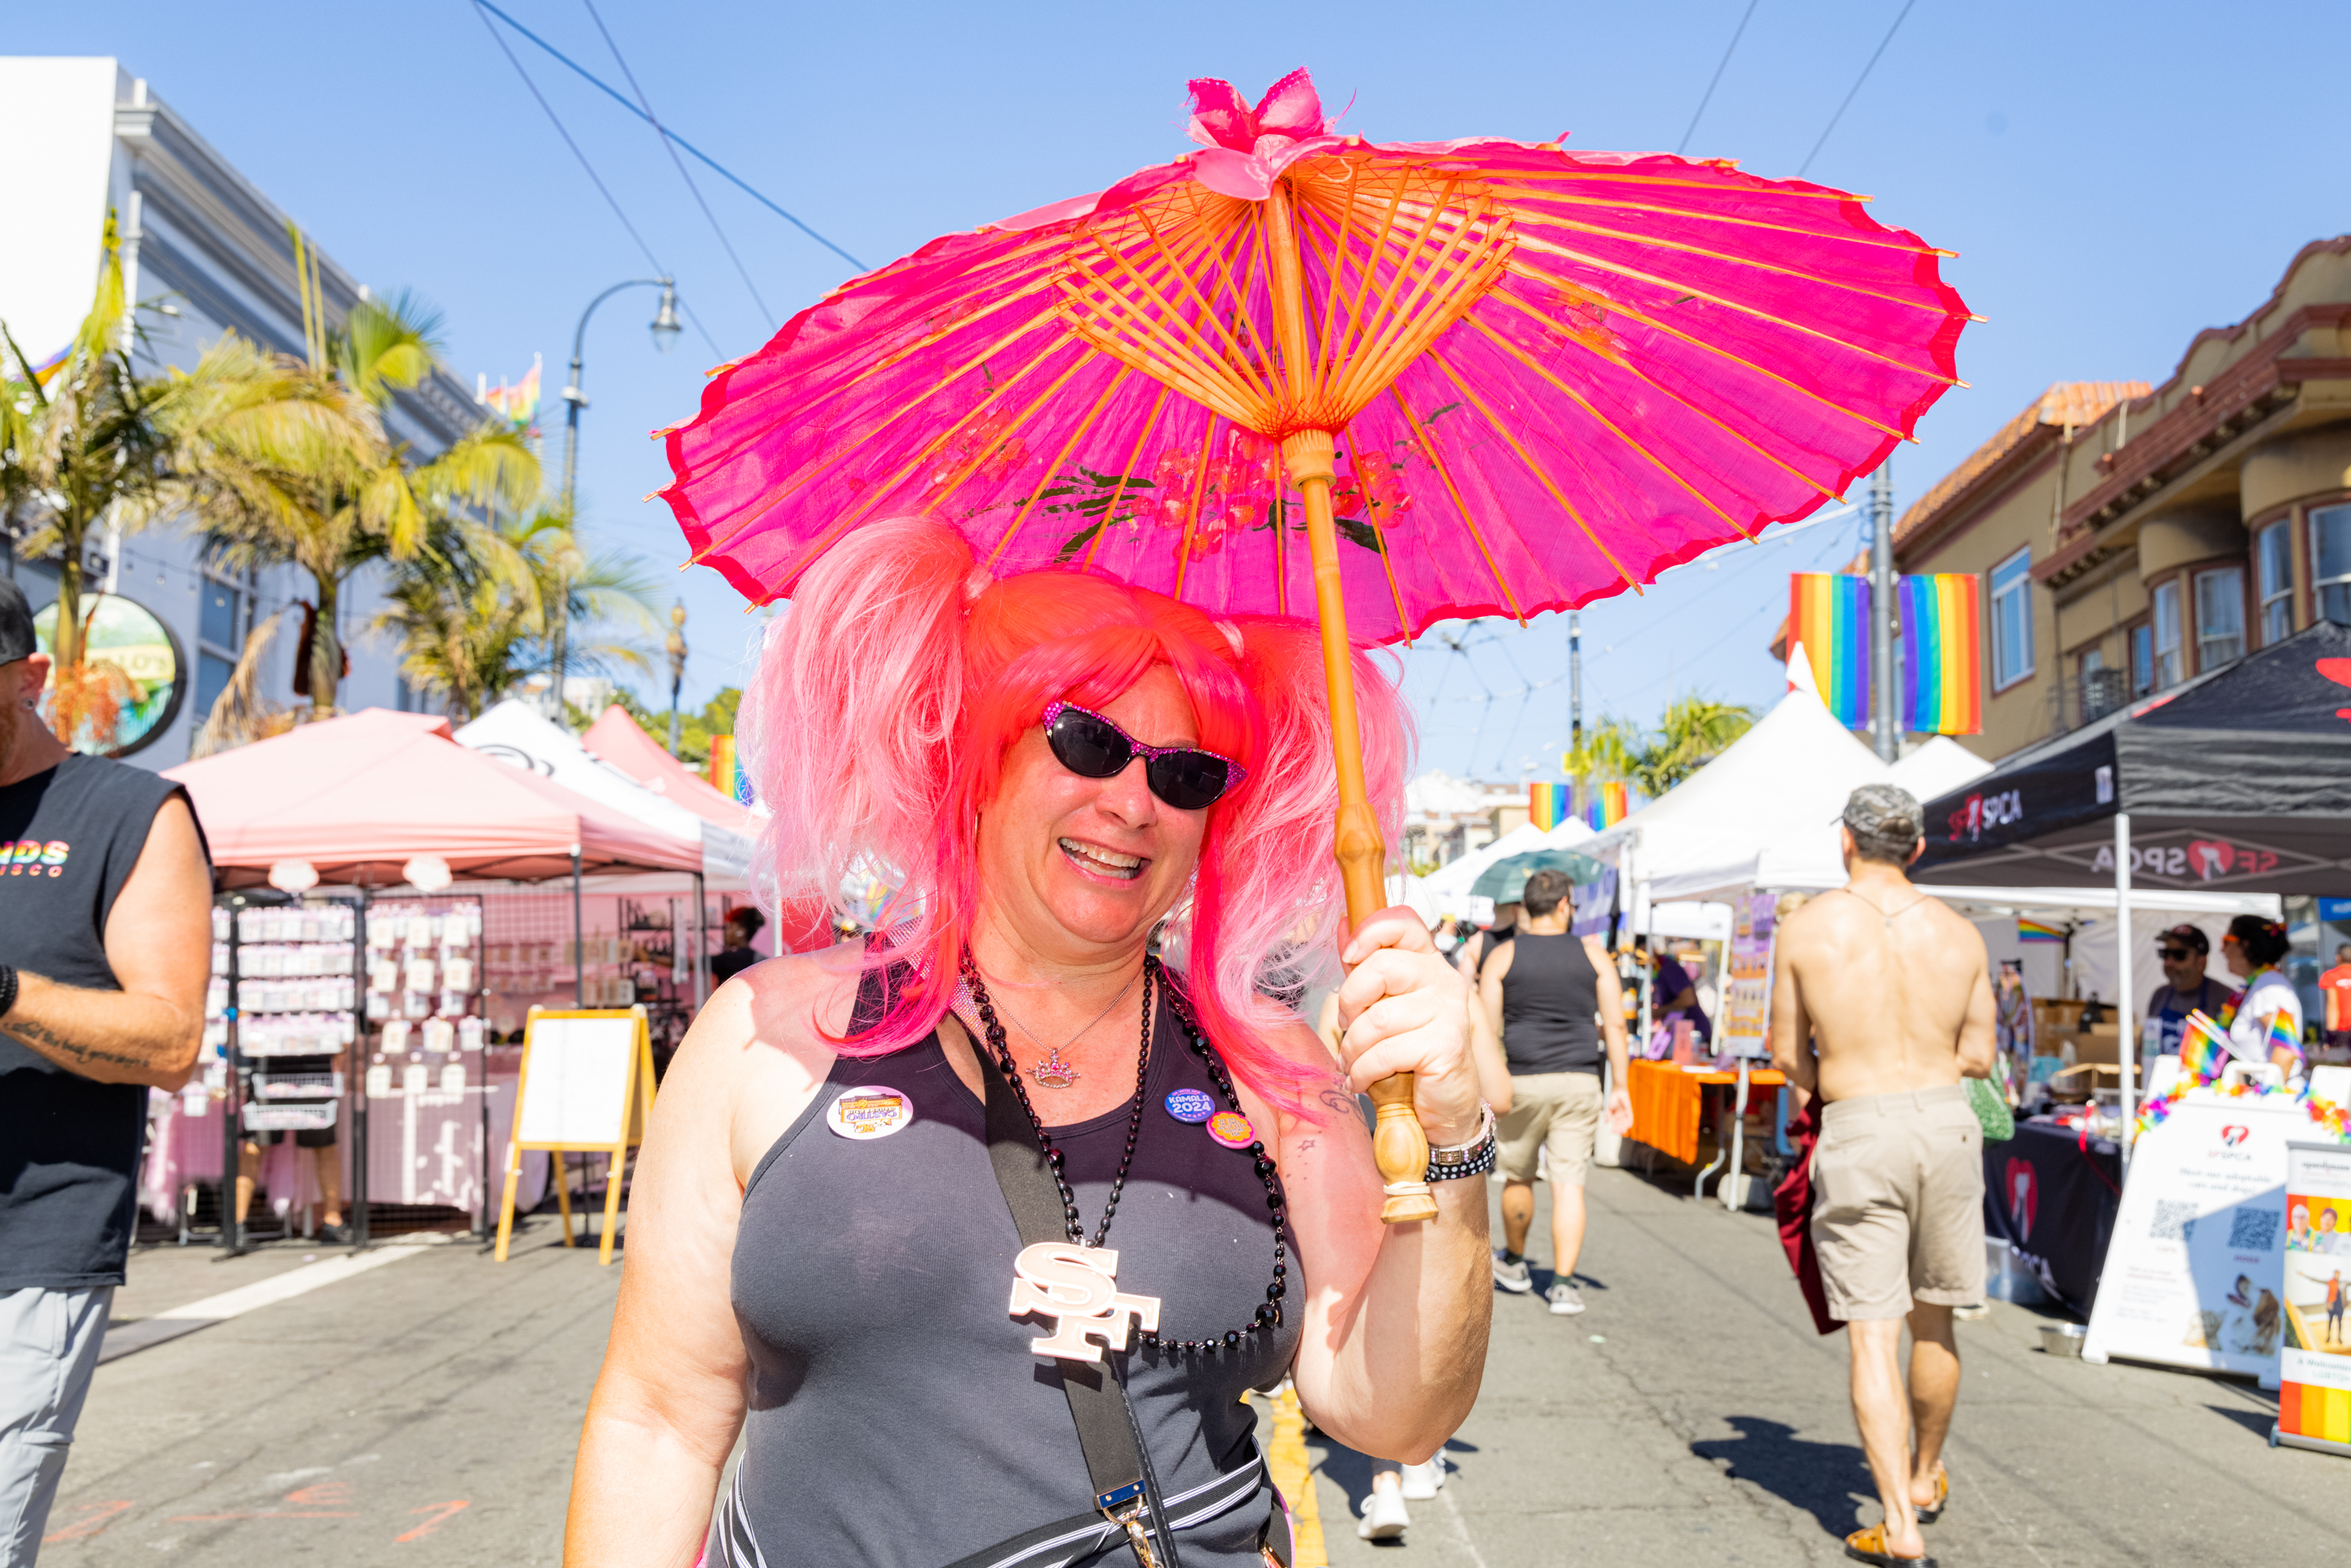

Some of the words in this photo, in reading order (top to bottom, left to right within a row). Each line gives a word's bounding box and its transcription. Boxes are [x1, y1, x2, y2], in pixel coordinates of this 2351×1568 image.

[1982, 788, 2023, 830] SPCA
[858, 1099, 868, 1110] 6
[1168, 1095, 1210, 1103] KAMALA
[1172, 1102, 1211, 1113] 2024
[846, 1110, 897, 1121] CASTRO
[1009, 1242, 1161, 1363] SF
